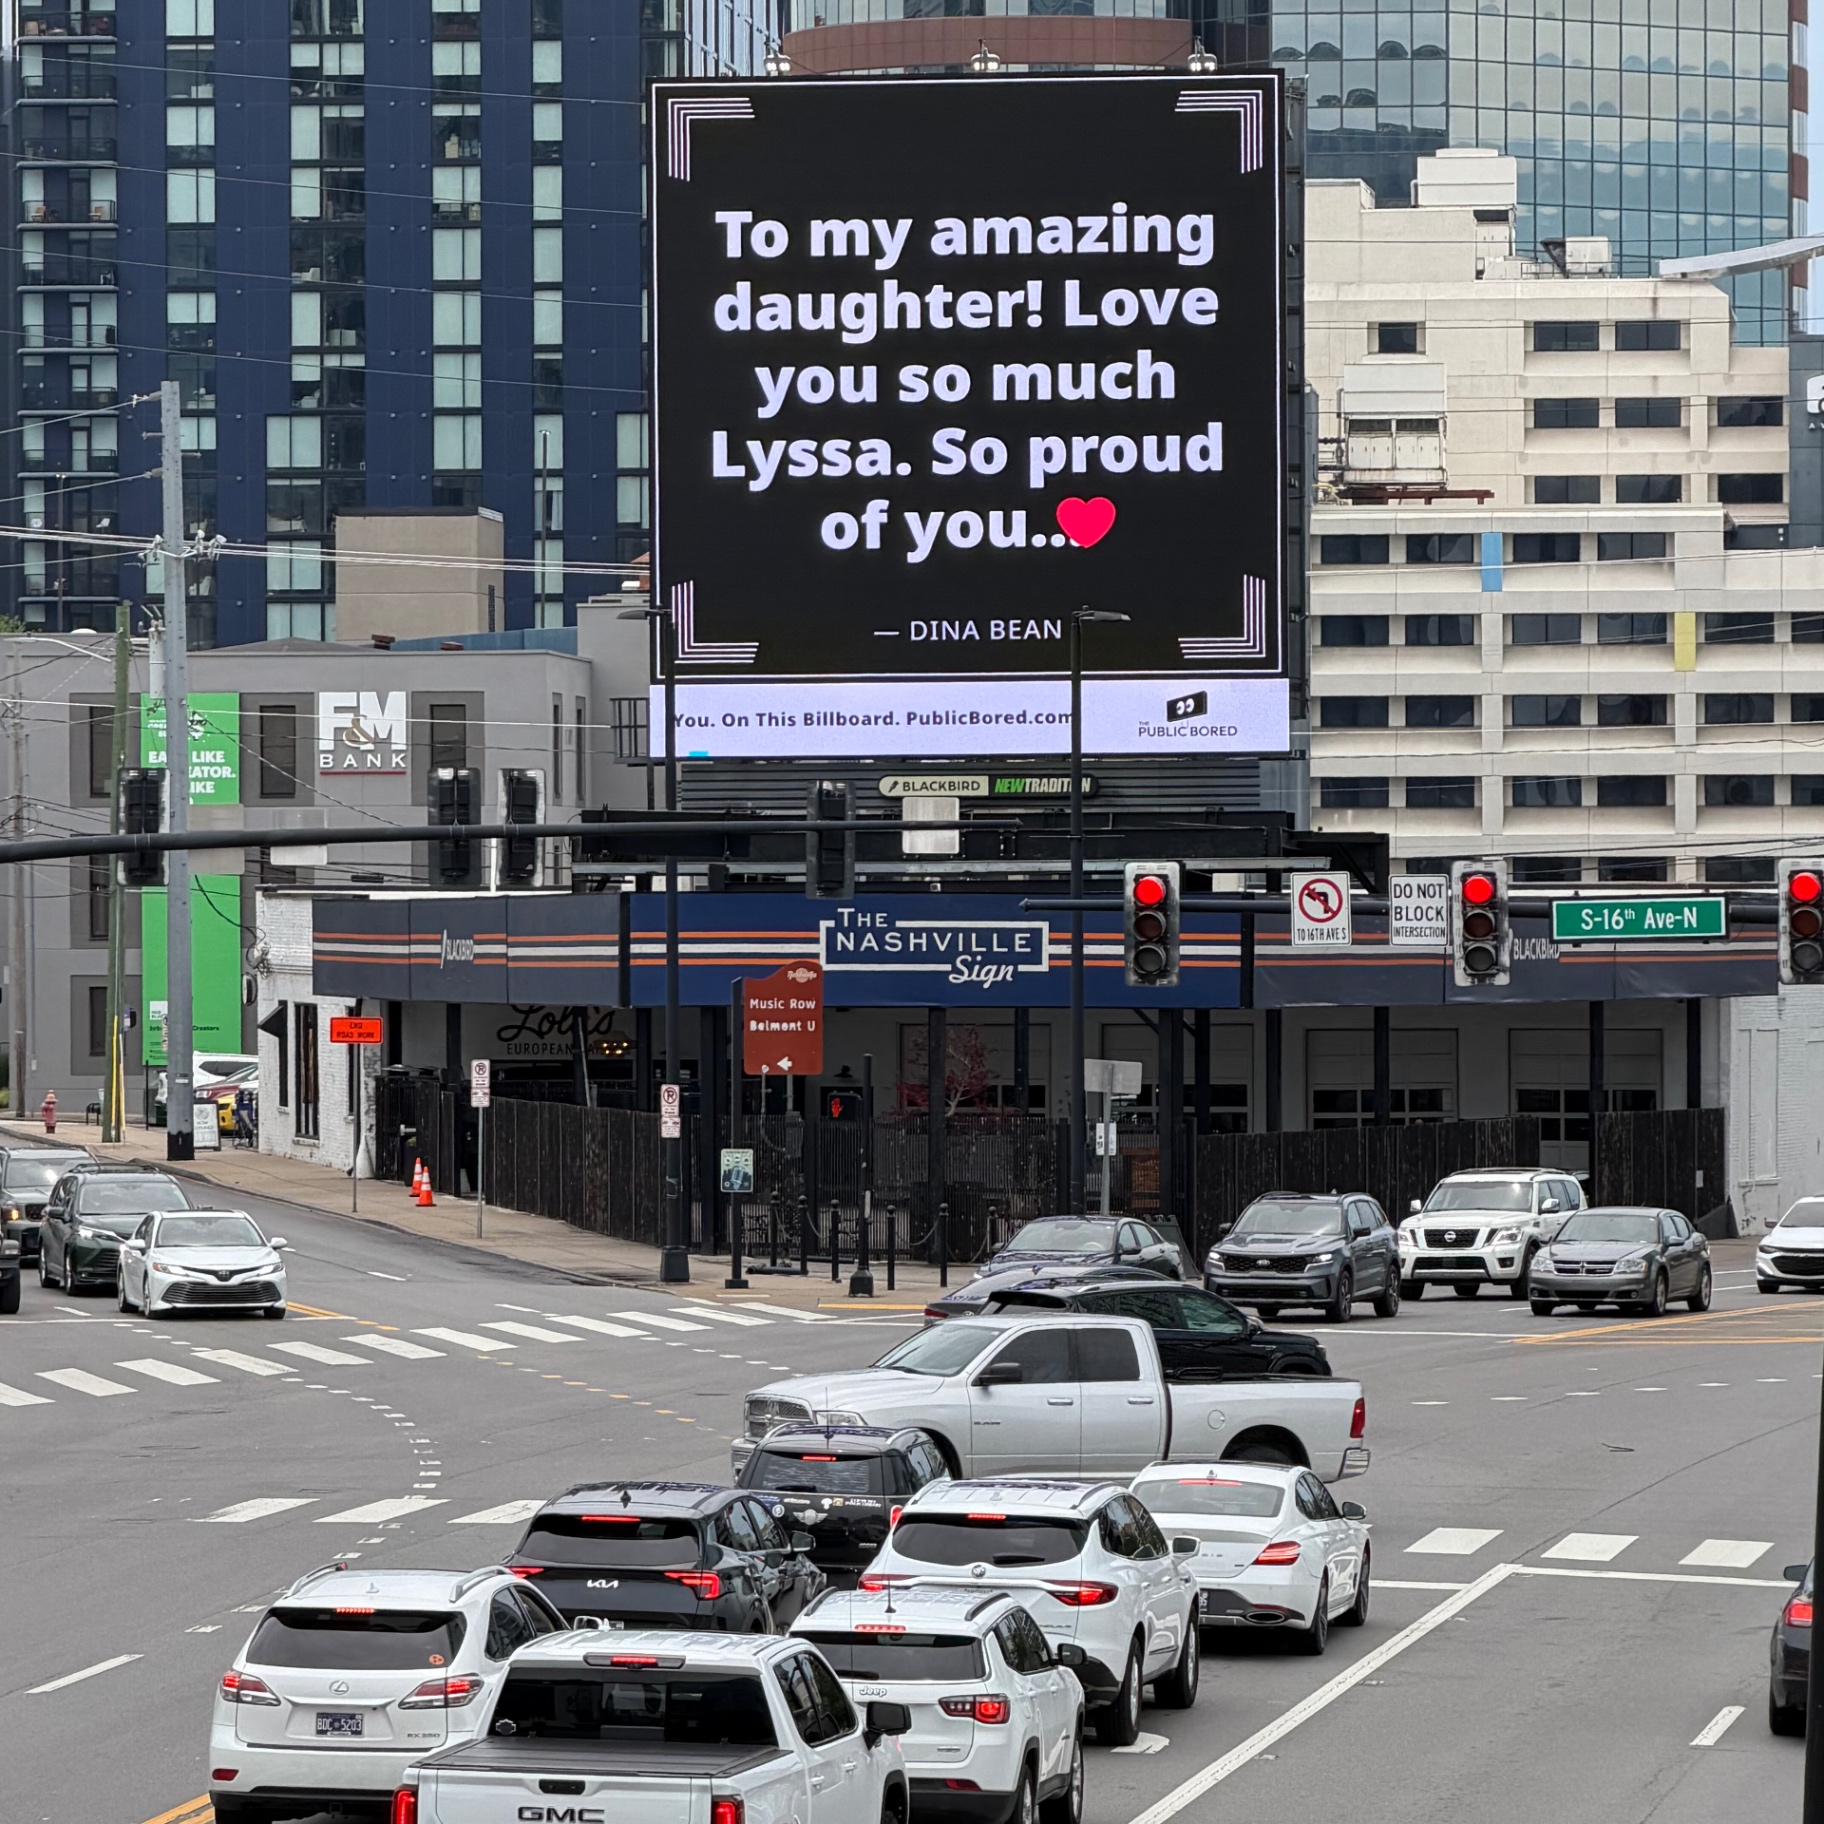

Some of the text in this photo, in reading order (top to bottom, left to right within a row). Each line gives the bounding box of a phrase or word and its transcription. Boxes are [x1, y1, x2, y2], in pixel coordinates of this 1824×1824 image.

[714, 202, 1215, 270] To my amazing
[713, 279, 1219, 344] daughter! Love
[754, 349, 1175, 419] you so much
[712, 421, 1223, 492] Lyssa. So proud
[820, 499, 890, 550] of
[910, 620, 980, 641] DINA
[990, 619, 1062, 640] BEAN
[318, 691, 408, 751] F&M
[675, 709, 1073, 727] You. On This Billboard. PublicBored.com
[1138, 725, 1238, 738] PUBLIC BORED
[191, 750, 225, 763] LIKE
[319, 752, 407, 769] BANK
[902, 779, 981, 792] BLACKBIRD
[1393, 882, 1445, 899] DO NOT
[837, 907, 888, 927] THE
[1393, 905, 1445, 922] BLOCK
[1581, 906, 1697, 931] S-16th Ave-N
[1297, 926, 1347, 941] TO 16TH AVE S
[1393, 925, 1447, 938] INTERSECTION
[836, 931, 1032, 953] NASHVILLE
[948, 954, 1014, 989] Sign
[749, 997, 816, 1010] Music Row
[749, 1019, 816, 1032] Belmont U
[507, 1043, 574, 1056] EUROPEAN
[859, 1685, 887, 1697] Jeep
[341, 1718, 362, 1731] 5203
[517, 1806, 605, 1823] GMC
